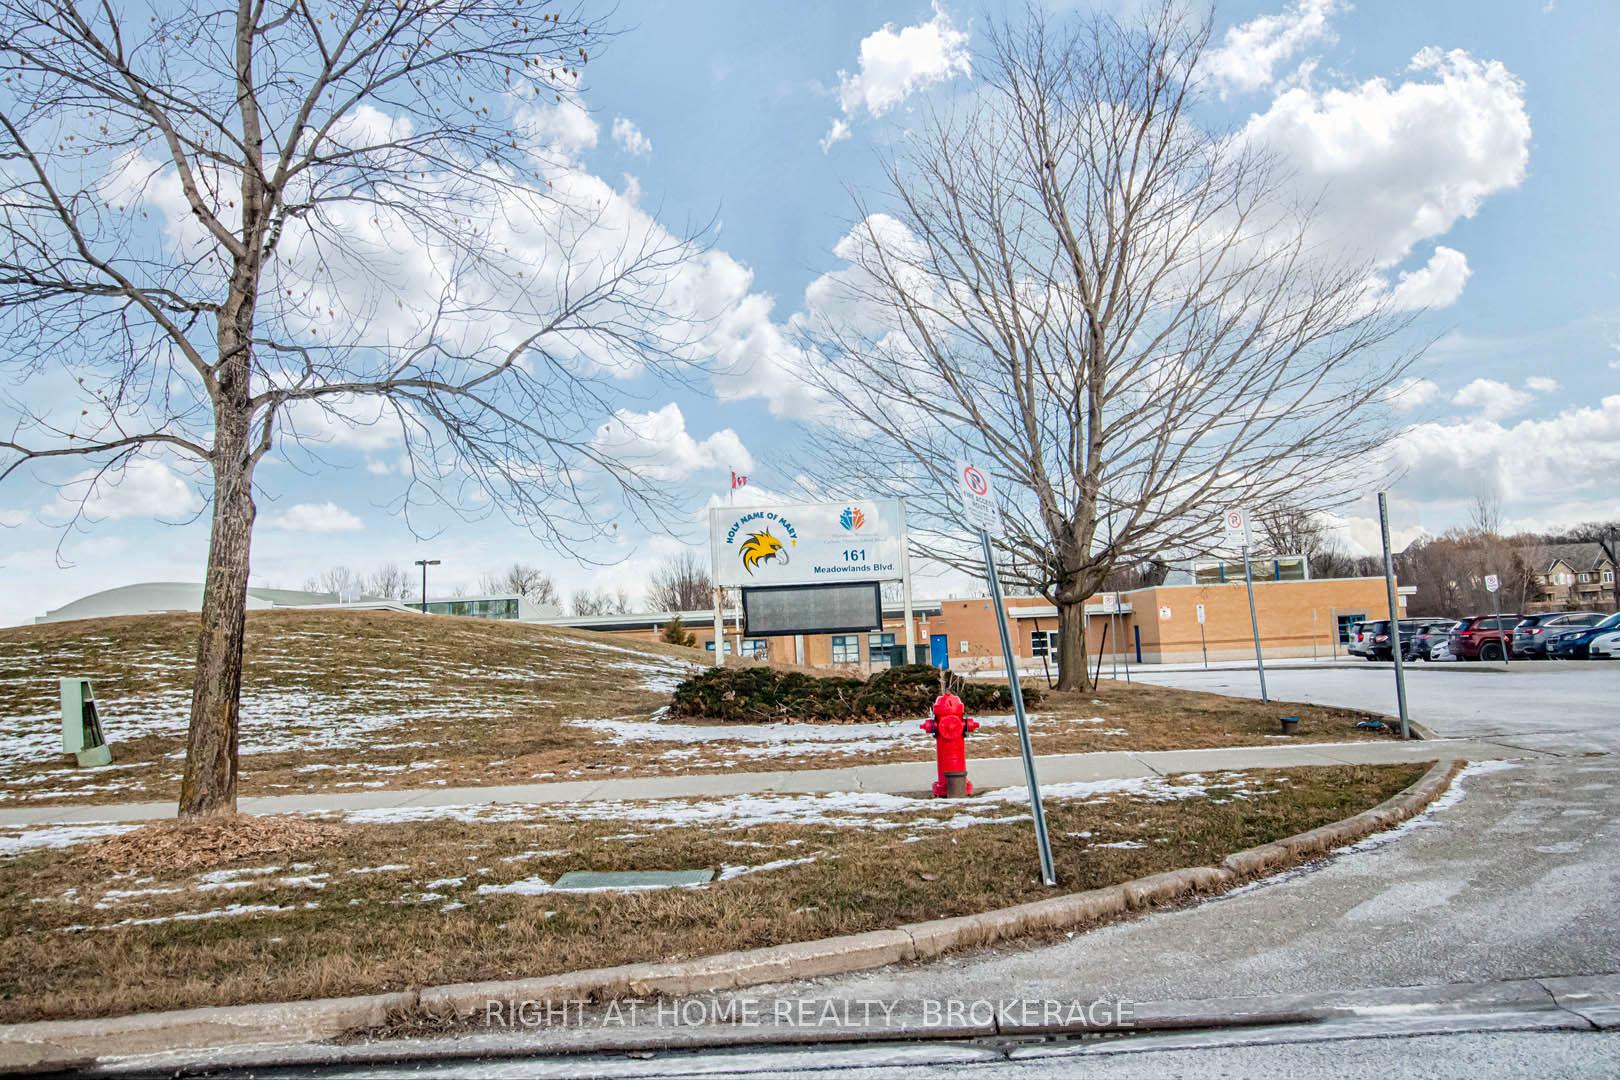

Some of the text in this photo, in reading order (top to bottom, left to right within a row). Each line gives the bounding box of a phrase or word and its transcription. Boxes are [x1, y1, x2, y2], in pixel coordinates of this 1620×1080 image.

[726, 511, 798, 544] HOLY NAME OF MARY
[843, 549, 865, 561] 161
[814, 563, 895, 573] Meadowlands Blvd.
